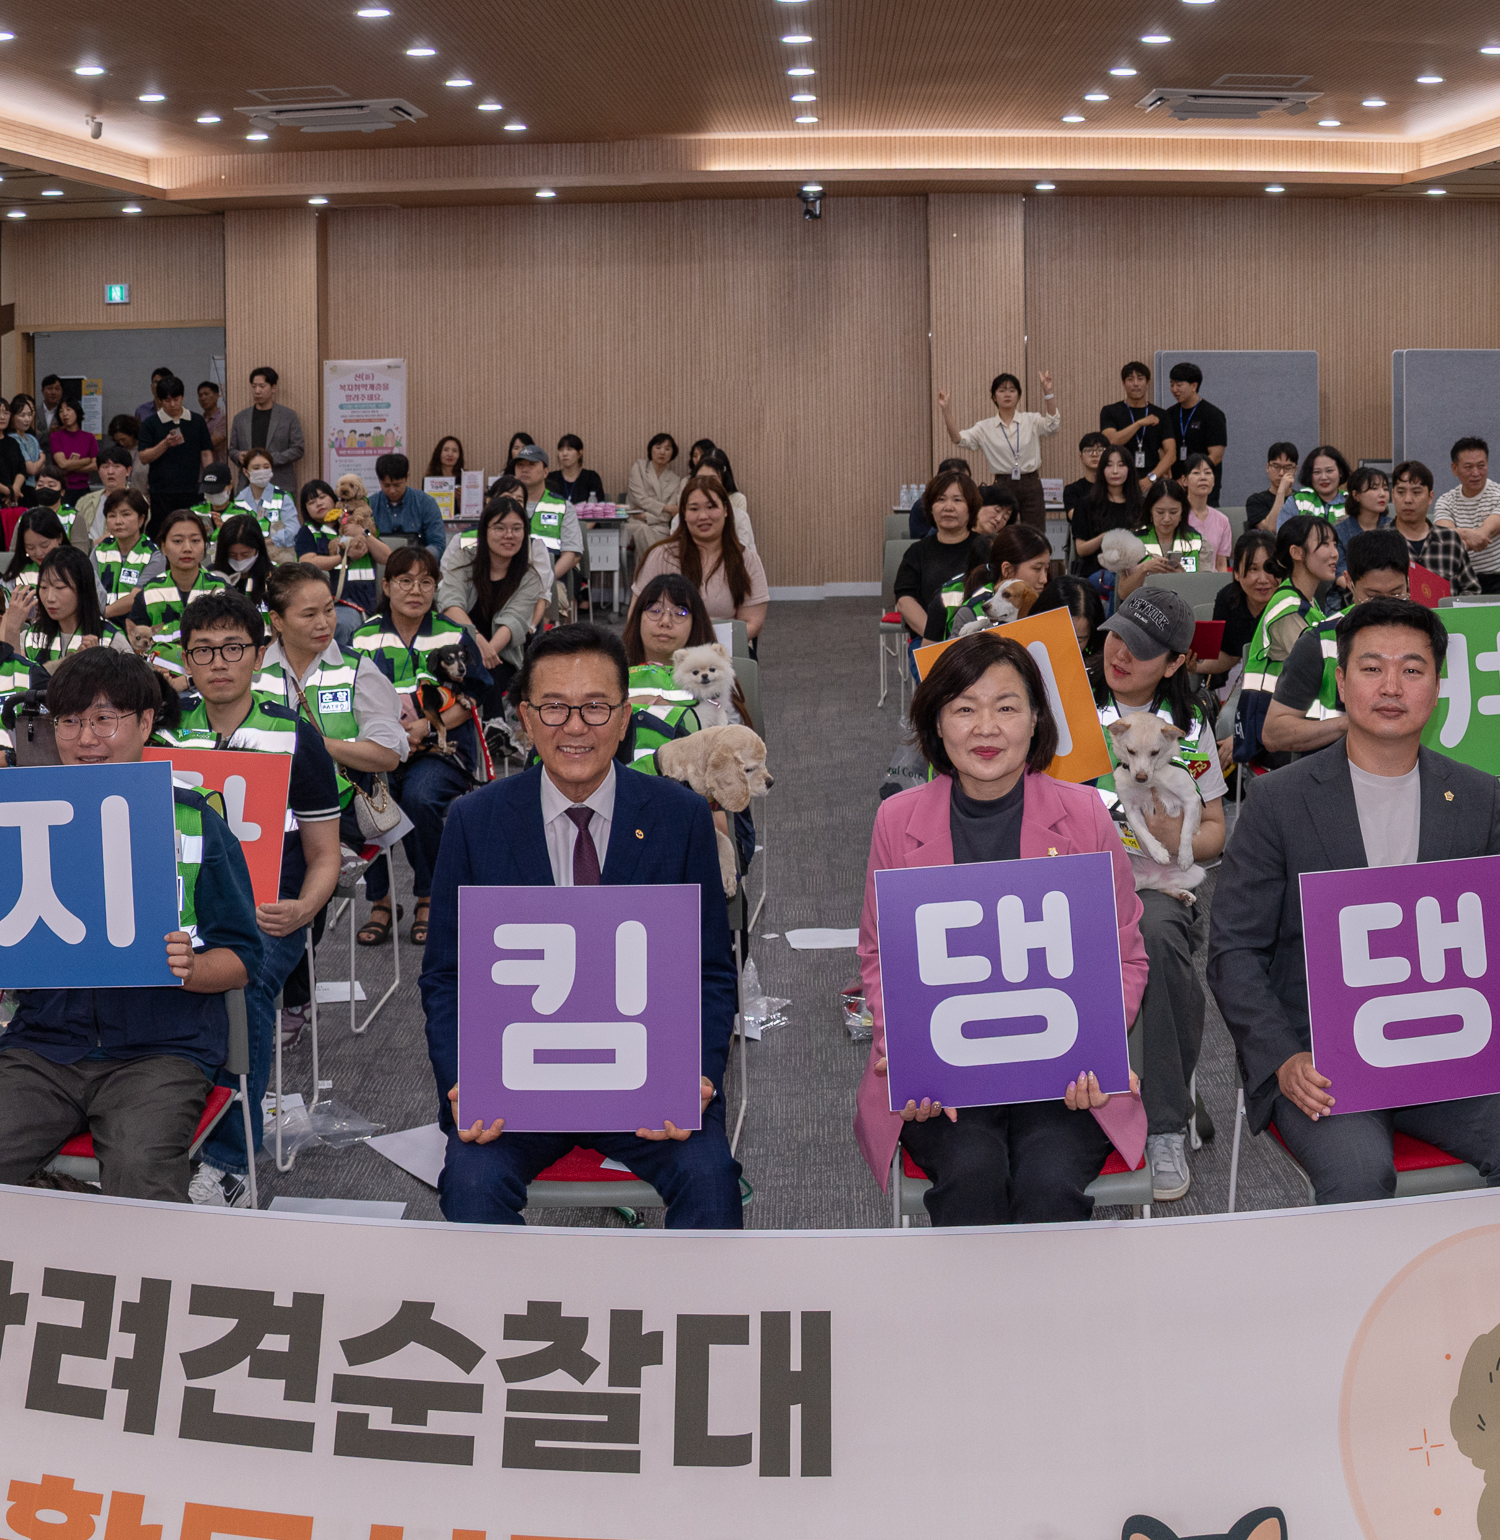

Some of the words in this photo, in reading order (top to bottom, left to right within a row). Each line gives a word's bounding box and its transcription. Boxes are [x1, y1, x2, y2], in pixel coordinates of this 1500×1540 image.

[491, 920, 647, 1091] 킴
[915, 891, 1078, 1067] 댕
[1338, 892, 1493, 1068] 댕
